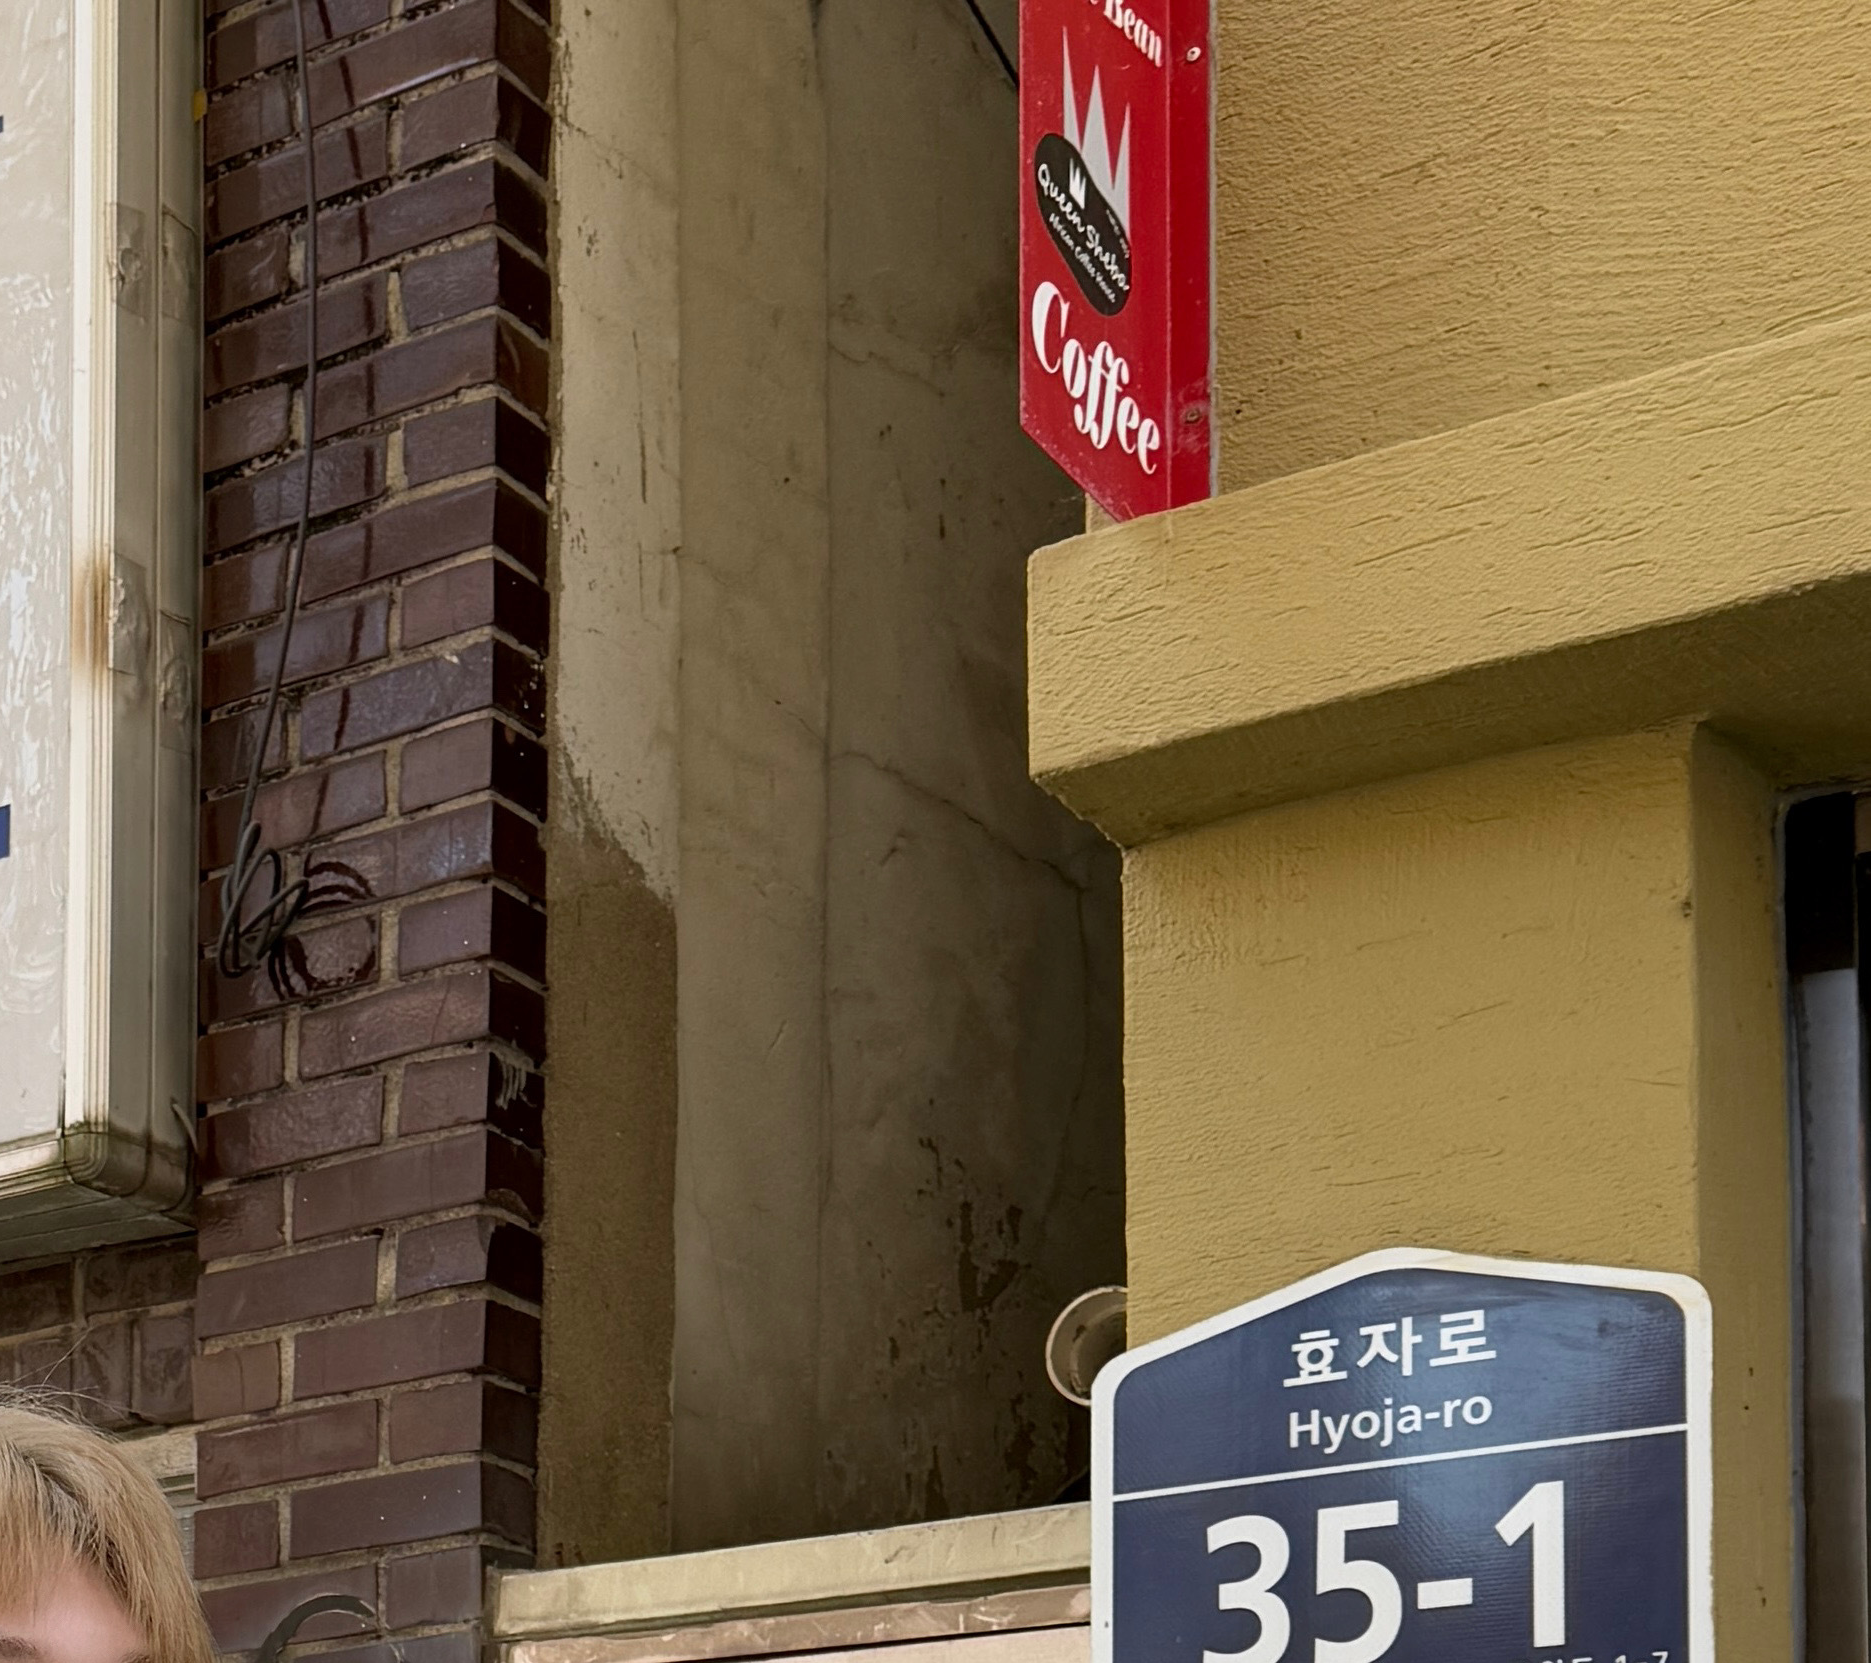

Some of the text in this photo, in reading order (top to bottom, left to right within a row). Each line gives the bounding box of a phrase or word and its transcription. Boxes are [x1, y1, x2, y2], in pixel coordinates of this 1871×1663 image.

[1031, 280, 1161, 476] Coffee
[1282, 1308, 1498, 1389] 효자로
[1287, 1393, 1494, 1454] Hyoja-ro
